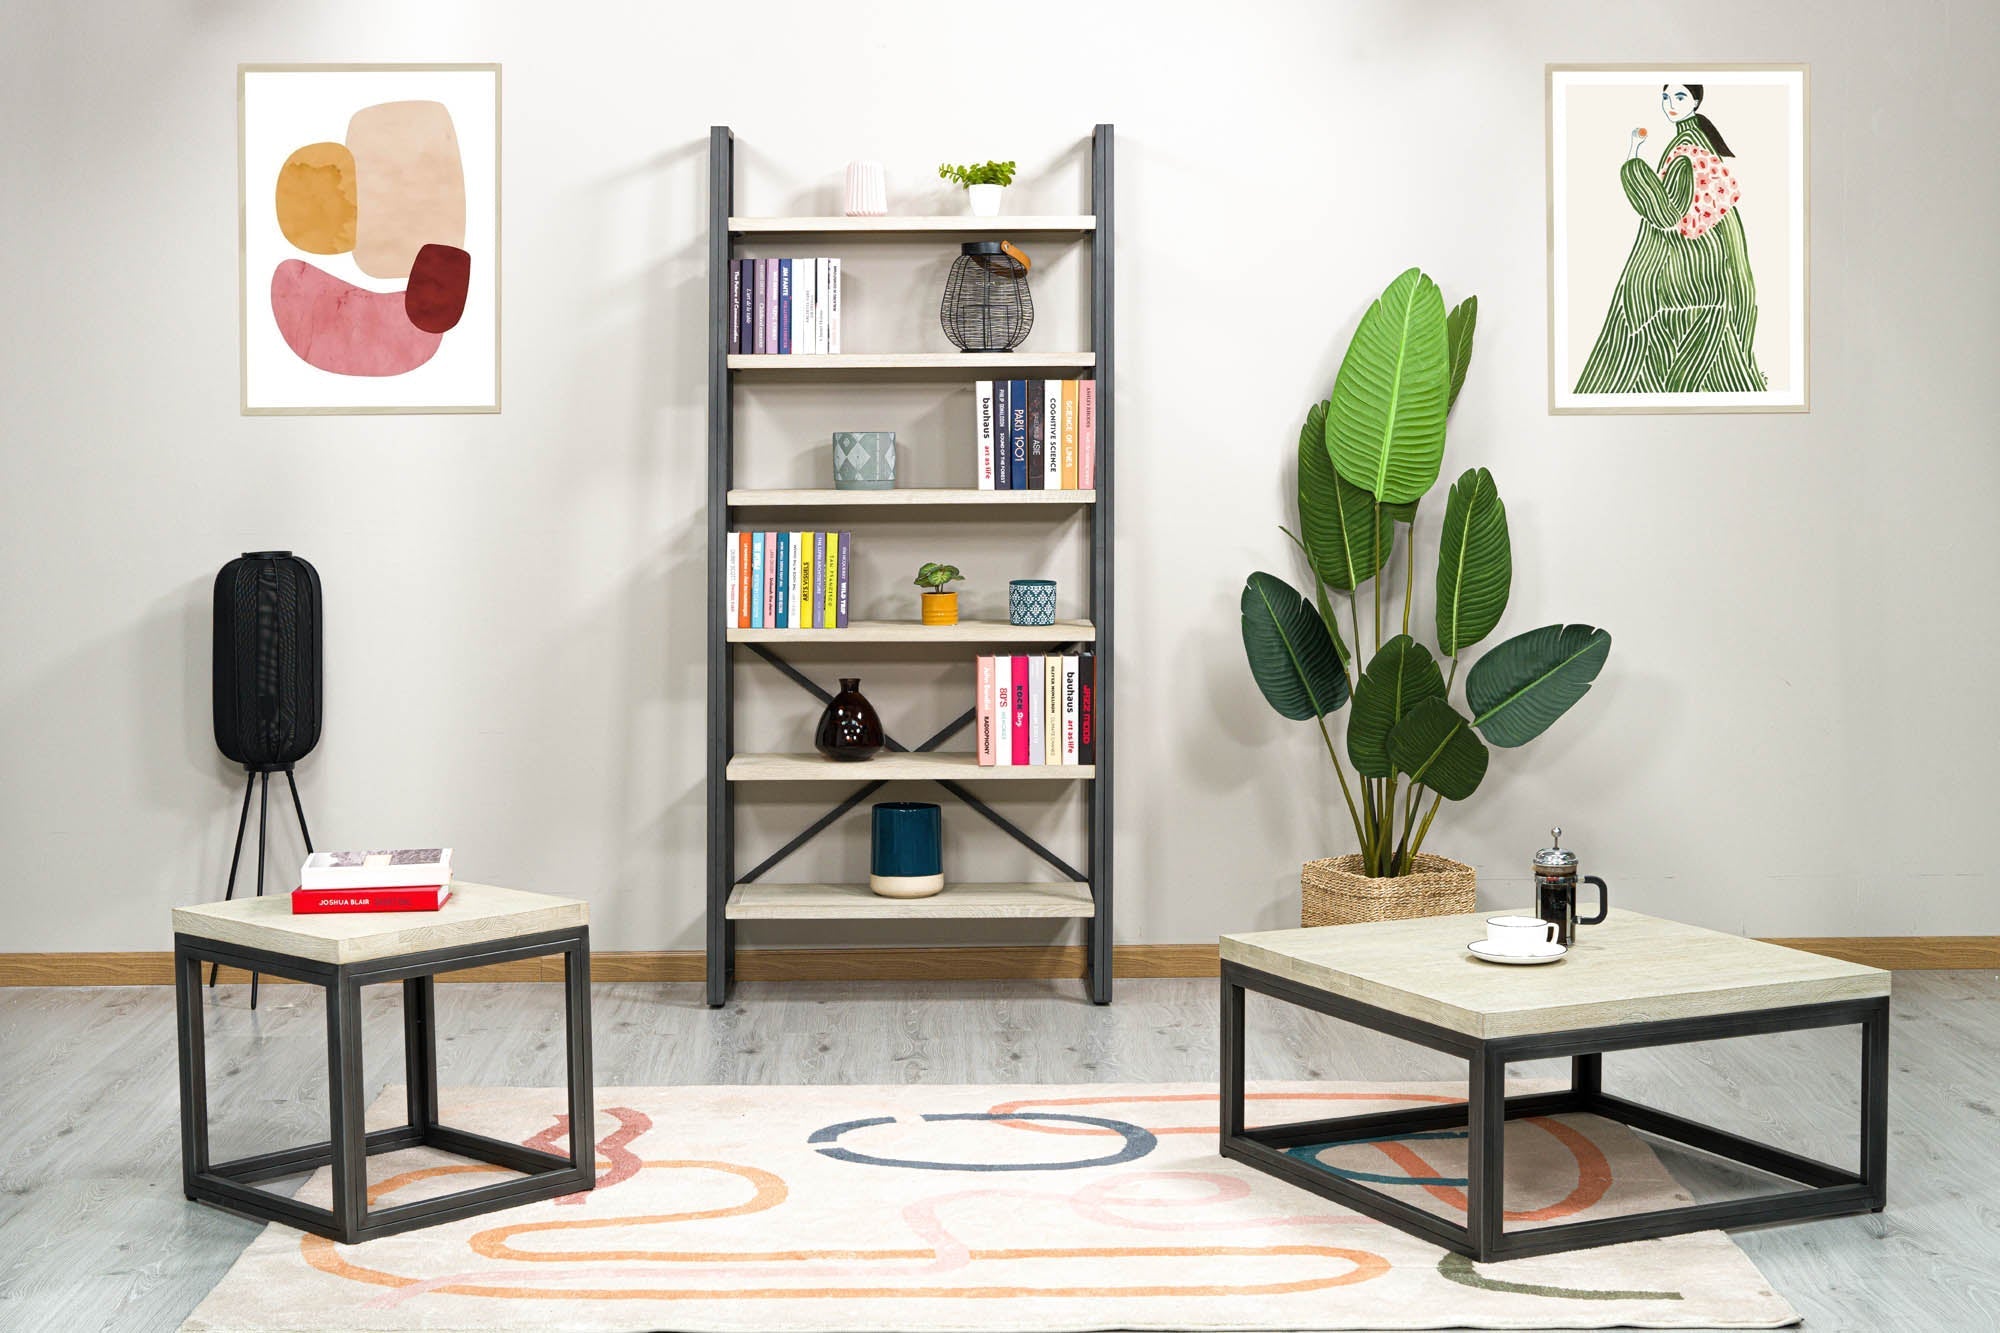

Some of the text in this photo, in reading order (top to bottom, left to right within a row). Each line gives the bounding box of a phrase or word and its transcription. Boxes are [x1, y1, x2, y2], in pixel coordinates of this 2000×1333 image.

[1014, 410, 1024, 461] PARIS 1901
[1066, 435, 1072, 443] OF
[999, 688, 1007, 707] 80'S
[1067, 672, 1075, 713] bauhaus
[1068, 732, 1073, 740] as
